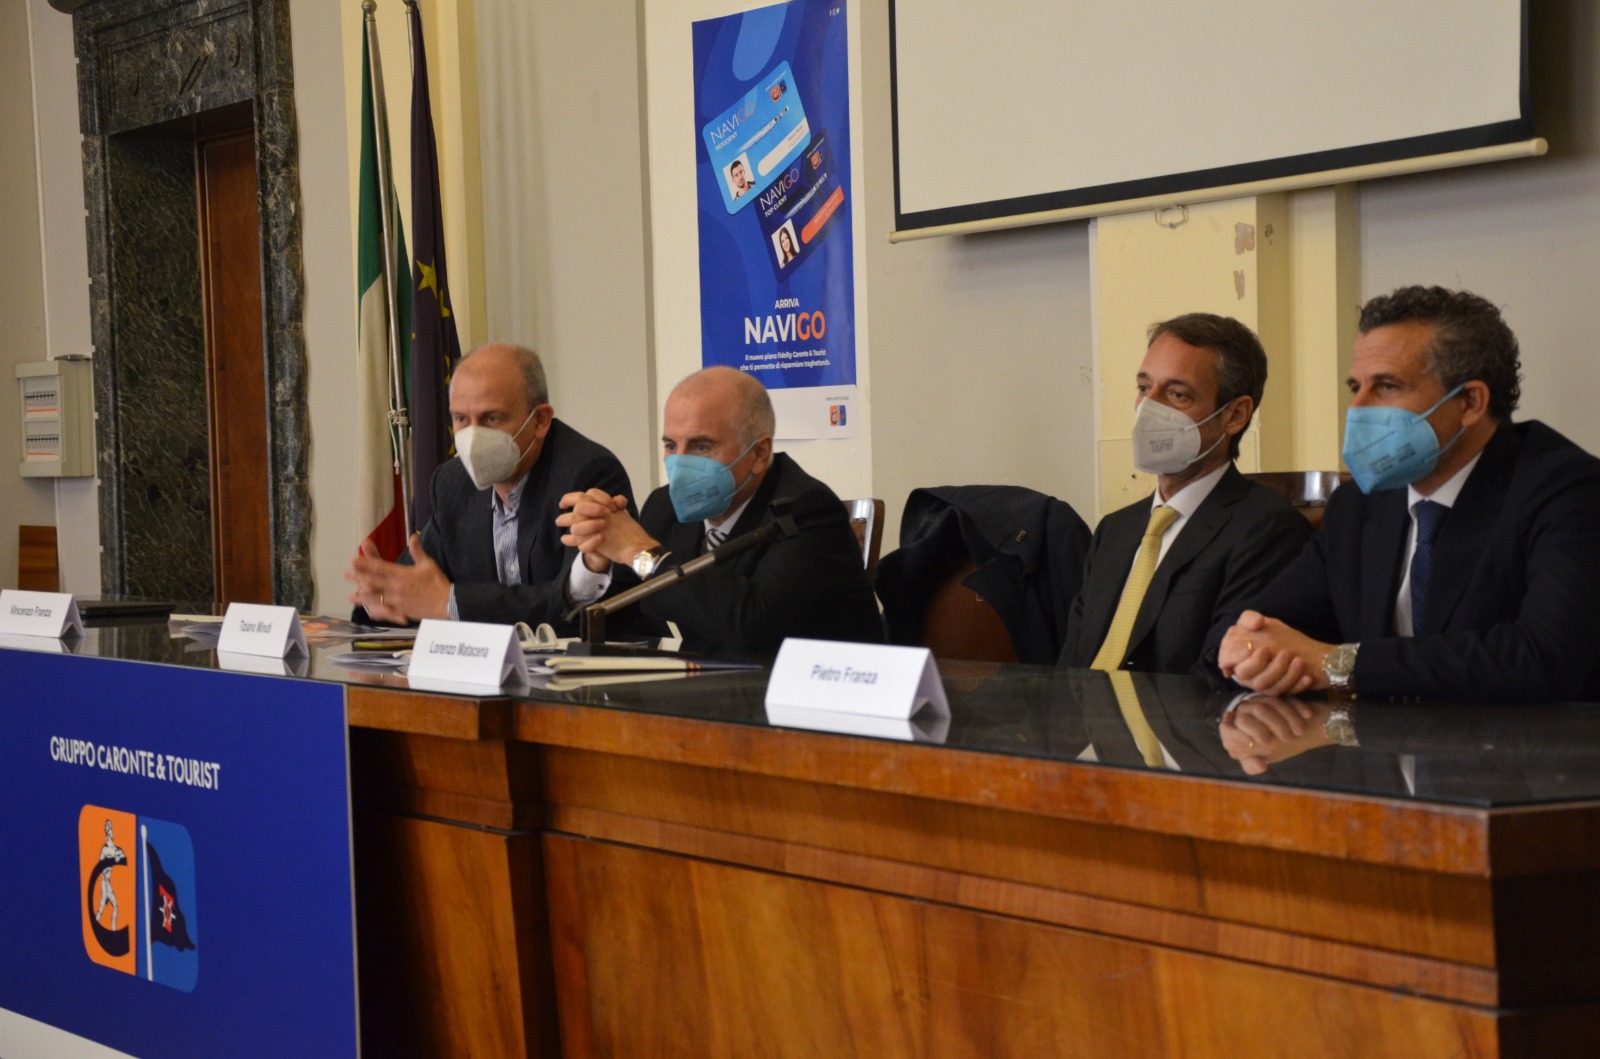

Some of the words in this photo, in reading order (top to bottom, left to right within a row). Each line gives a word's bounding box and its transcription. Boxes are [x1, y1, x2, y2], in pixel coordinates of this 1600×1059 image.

[710, 101, 755, 144] NAVIGO
[759, 168, 799, 210] NAVIGO
[764, 207, 774, 218] TOP
[773, 194, 787, 210] CLIENT
[774, 298, 800, 309] ARRIVA
[744, 310, 826, 345] NAVIGO
[777, 351, 793, 360] fidelity
[792, 350, 809, 358] Caronte
[10, 604, 34, 616] Vincenzo
[34, 605, 52, 617] Franza
[429, 640, 457, 656] Lorenzo
[457, 641, 490, 658] Matacena
[810, 664, 843, 682] Pietro
[842, 666, 878, 685] Franza
[50, 736, 95, 768] GRUPPO
[97, 745, 155, 779] CARONTE
[156, 753, 167, 781] &
[166, 754, 221, 791] TOURIST
